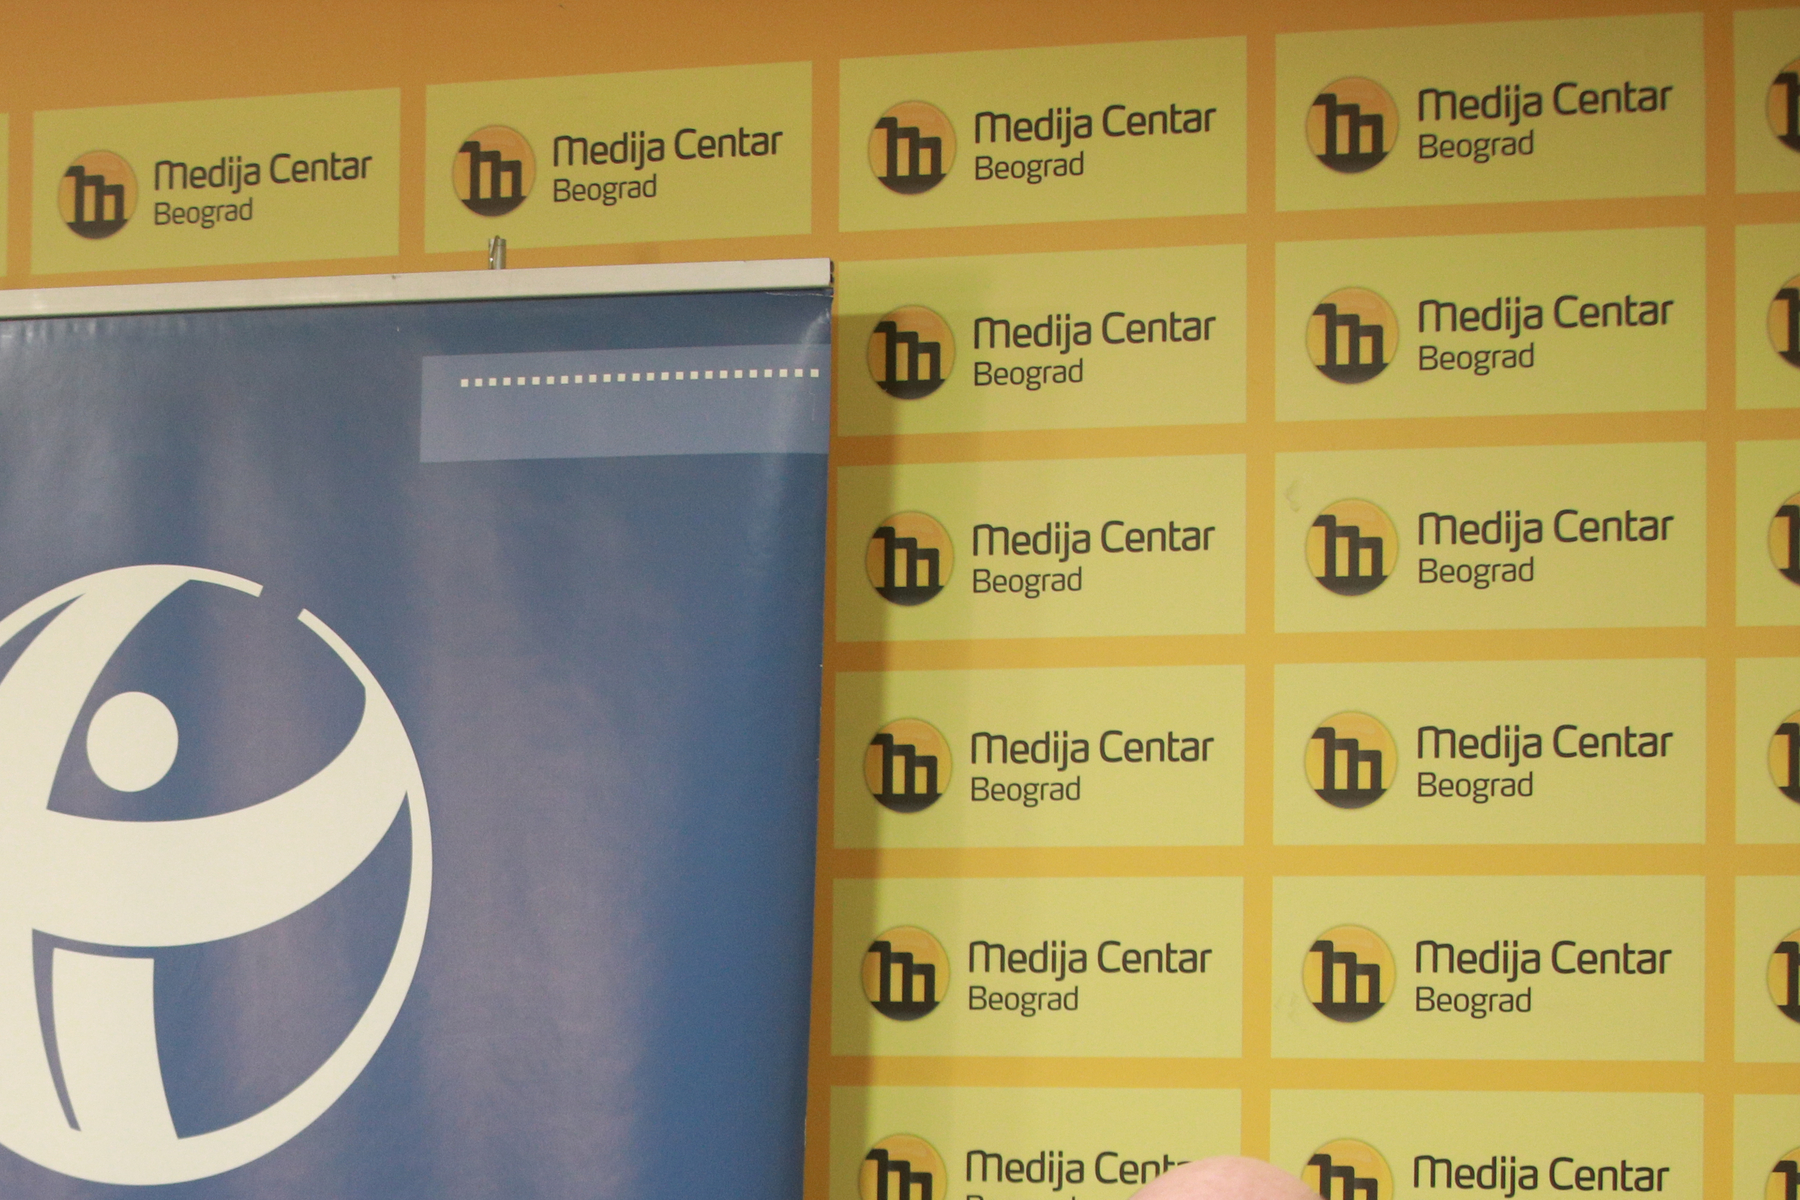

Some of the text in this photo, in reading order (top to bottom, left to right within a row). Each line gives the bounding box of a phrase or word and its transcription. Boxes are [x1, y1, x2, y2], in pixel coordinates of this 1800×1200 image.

[974, 102, 1218, 149] Medija Centar
[1417, 80, 1674, 128] Medija Centar
[552, 126, 784, 172] Medija Centar
[974, 150, 1085, 186] Beograd
[1417, 128, 1535, 165] Beograd
[153, 151, 374, 196] Medija Centar
[552, 172, 658, 208] Beograd
[153, 196, 254, 230] Beograd
[973, 310, 1217, 356] Medija Centar
[1417, 293, 1675, 340] Medija Centar
[973, 357, 1084, 392] Beograd
[1418, 341, 1535, 377] Beograd
[972, 519, 1217, 564] Medija Centar
[1417, 508, 1675, 554] Medija Centar
[972, 565, 1083, 600] Beograd
[1418, 555, 1535, 591] Beograd
[970, 728, 1215, 773] Medija Centar
[1416, 723, 1675, 768] Medija Centar
[970, 775, 1082, 809] Beograd
[1416, 770, 1534, 805] Beograd
[968, 939, 1213, 983] Medija Centar
[1415, 938, 1673, 984] Medija Centar
[968, 984, 1079, 1018] Beograd
[1415, 985, 1533, 1020] Beograd
[965, 1148, 1086, 1193] Medija
[1412, 1153, 1671, 1200] Medija Centar
